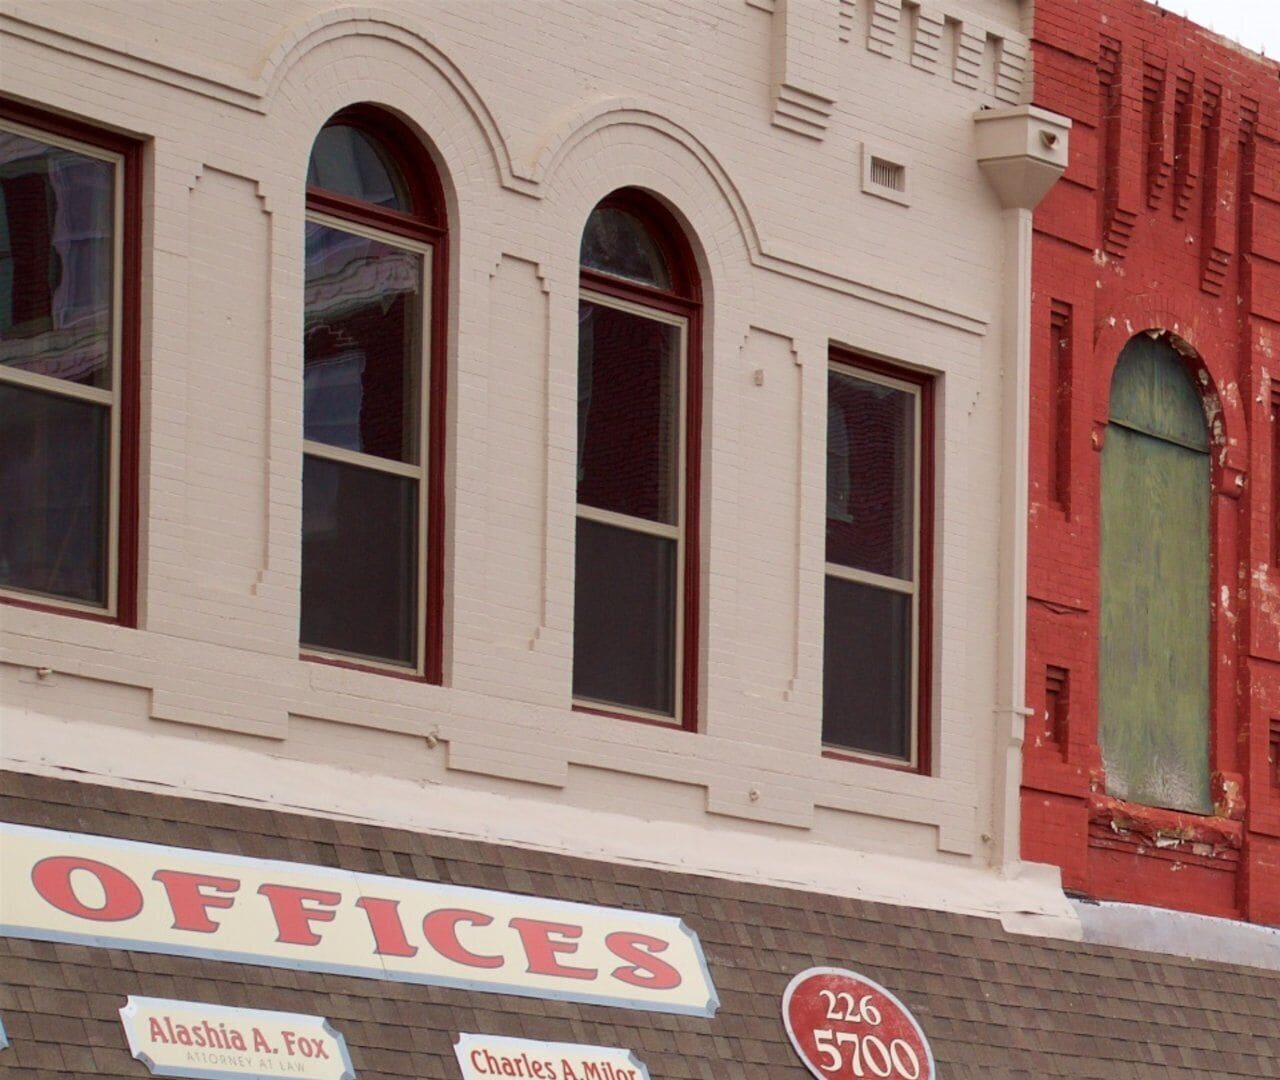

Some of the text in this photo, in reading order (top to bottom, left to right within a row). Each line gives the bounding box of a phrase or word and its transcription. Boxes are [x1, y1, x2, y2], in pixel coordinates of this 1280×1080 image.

[30, 855, 683, 991] OFFICES
[819, 989, 882, 1026] 226
[149, 1016, 330, 1060] Alashia A. Fox
[813, 1028, 920, 1080] 5700
[186, 1051, 306, 1073] ATTORNEY AT LAW
[470, 1049, 557, 1080] Charles
